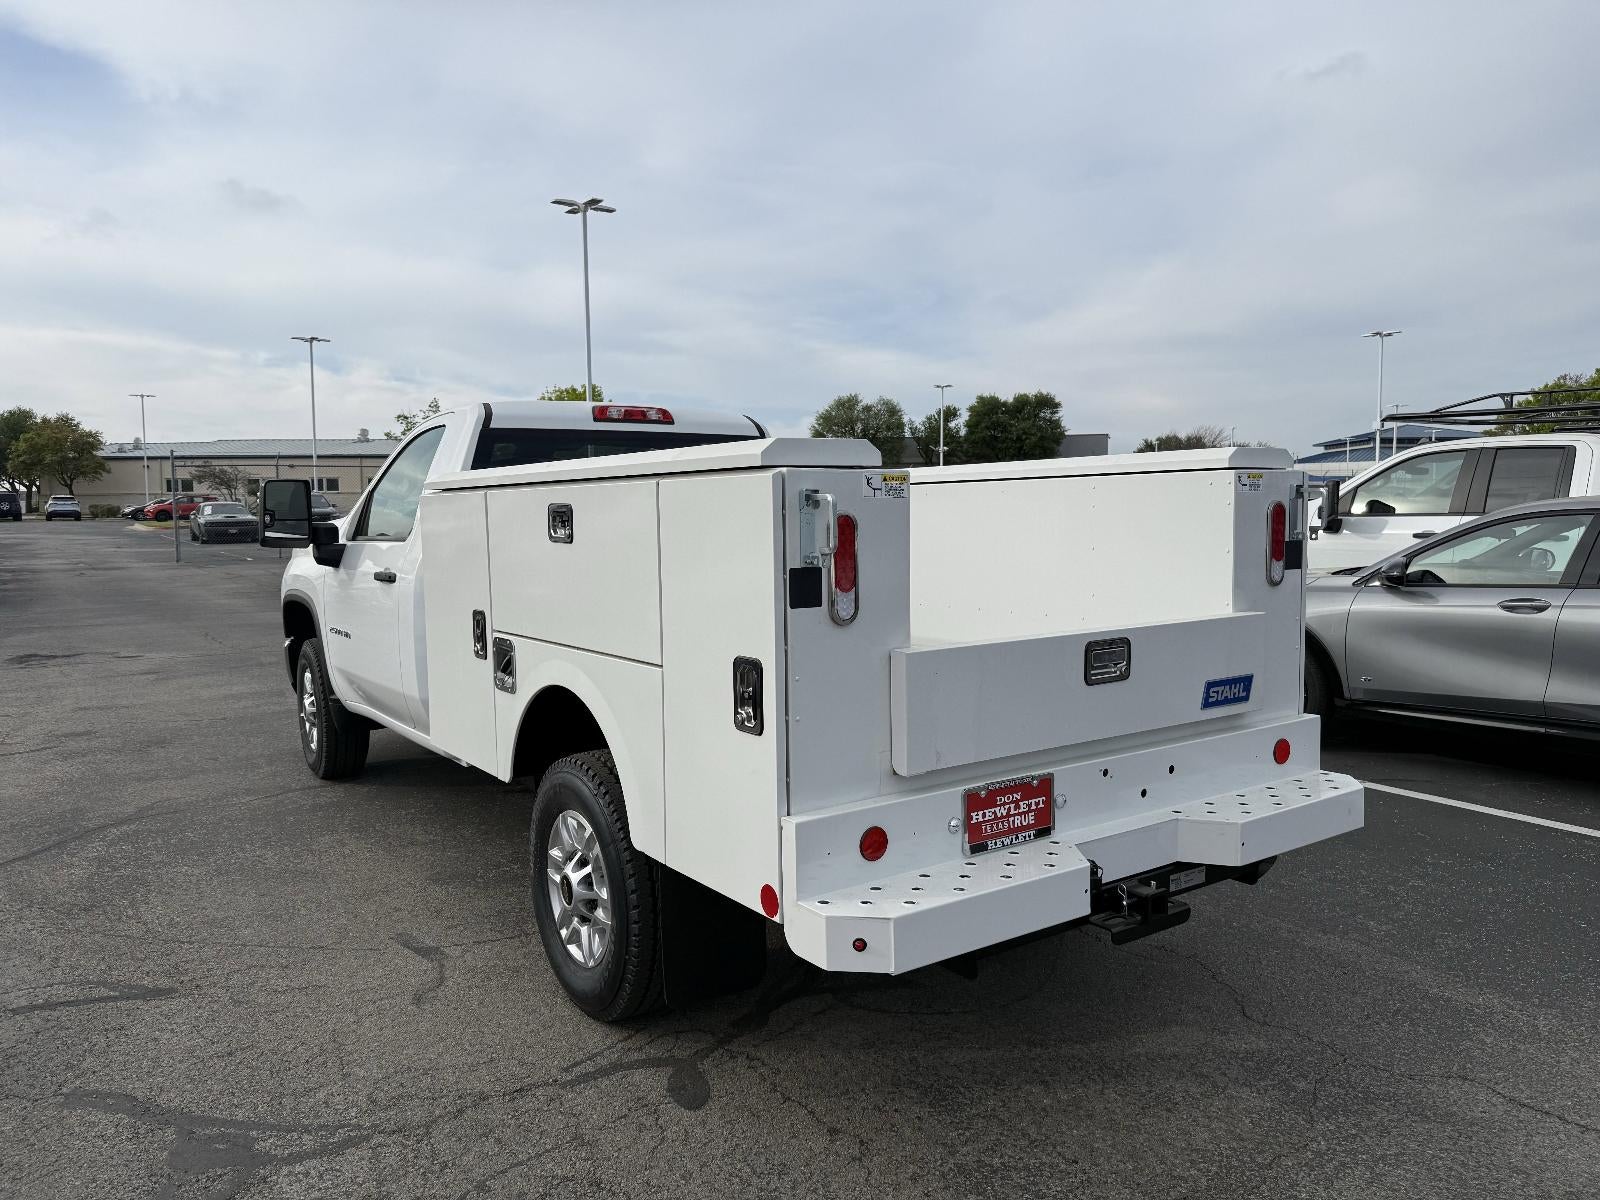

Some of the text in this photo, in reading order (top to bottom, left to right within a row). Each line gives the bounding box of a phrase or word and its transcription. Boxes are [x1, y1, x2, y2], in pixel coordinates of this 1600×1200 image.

[1208, 682, 1247, 702] STAHL
[996, 792, 1022, 804] DON
[970, 796, 1046, 823] HEWLETT
[987, 830, 1036, 850] HEWLETT
